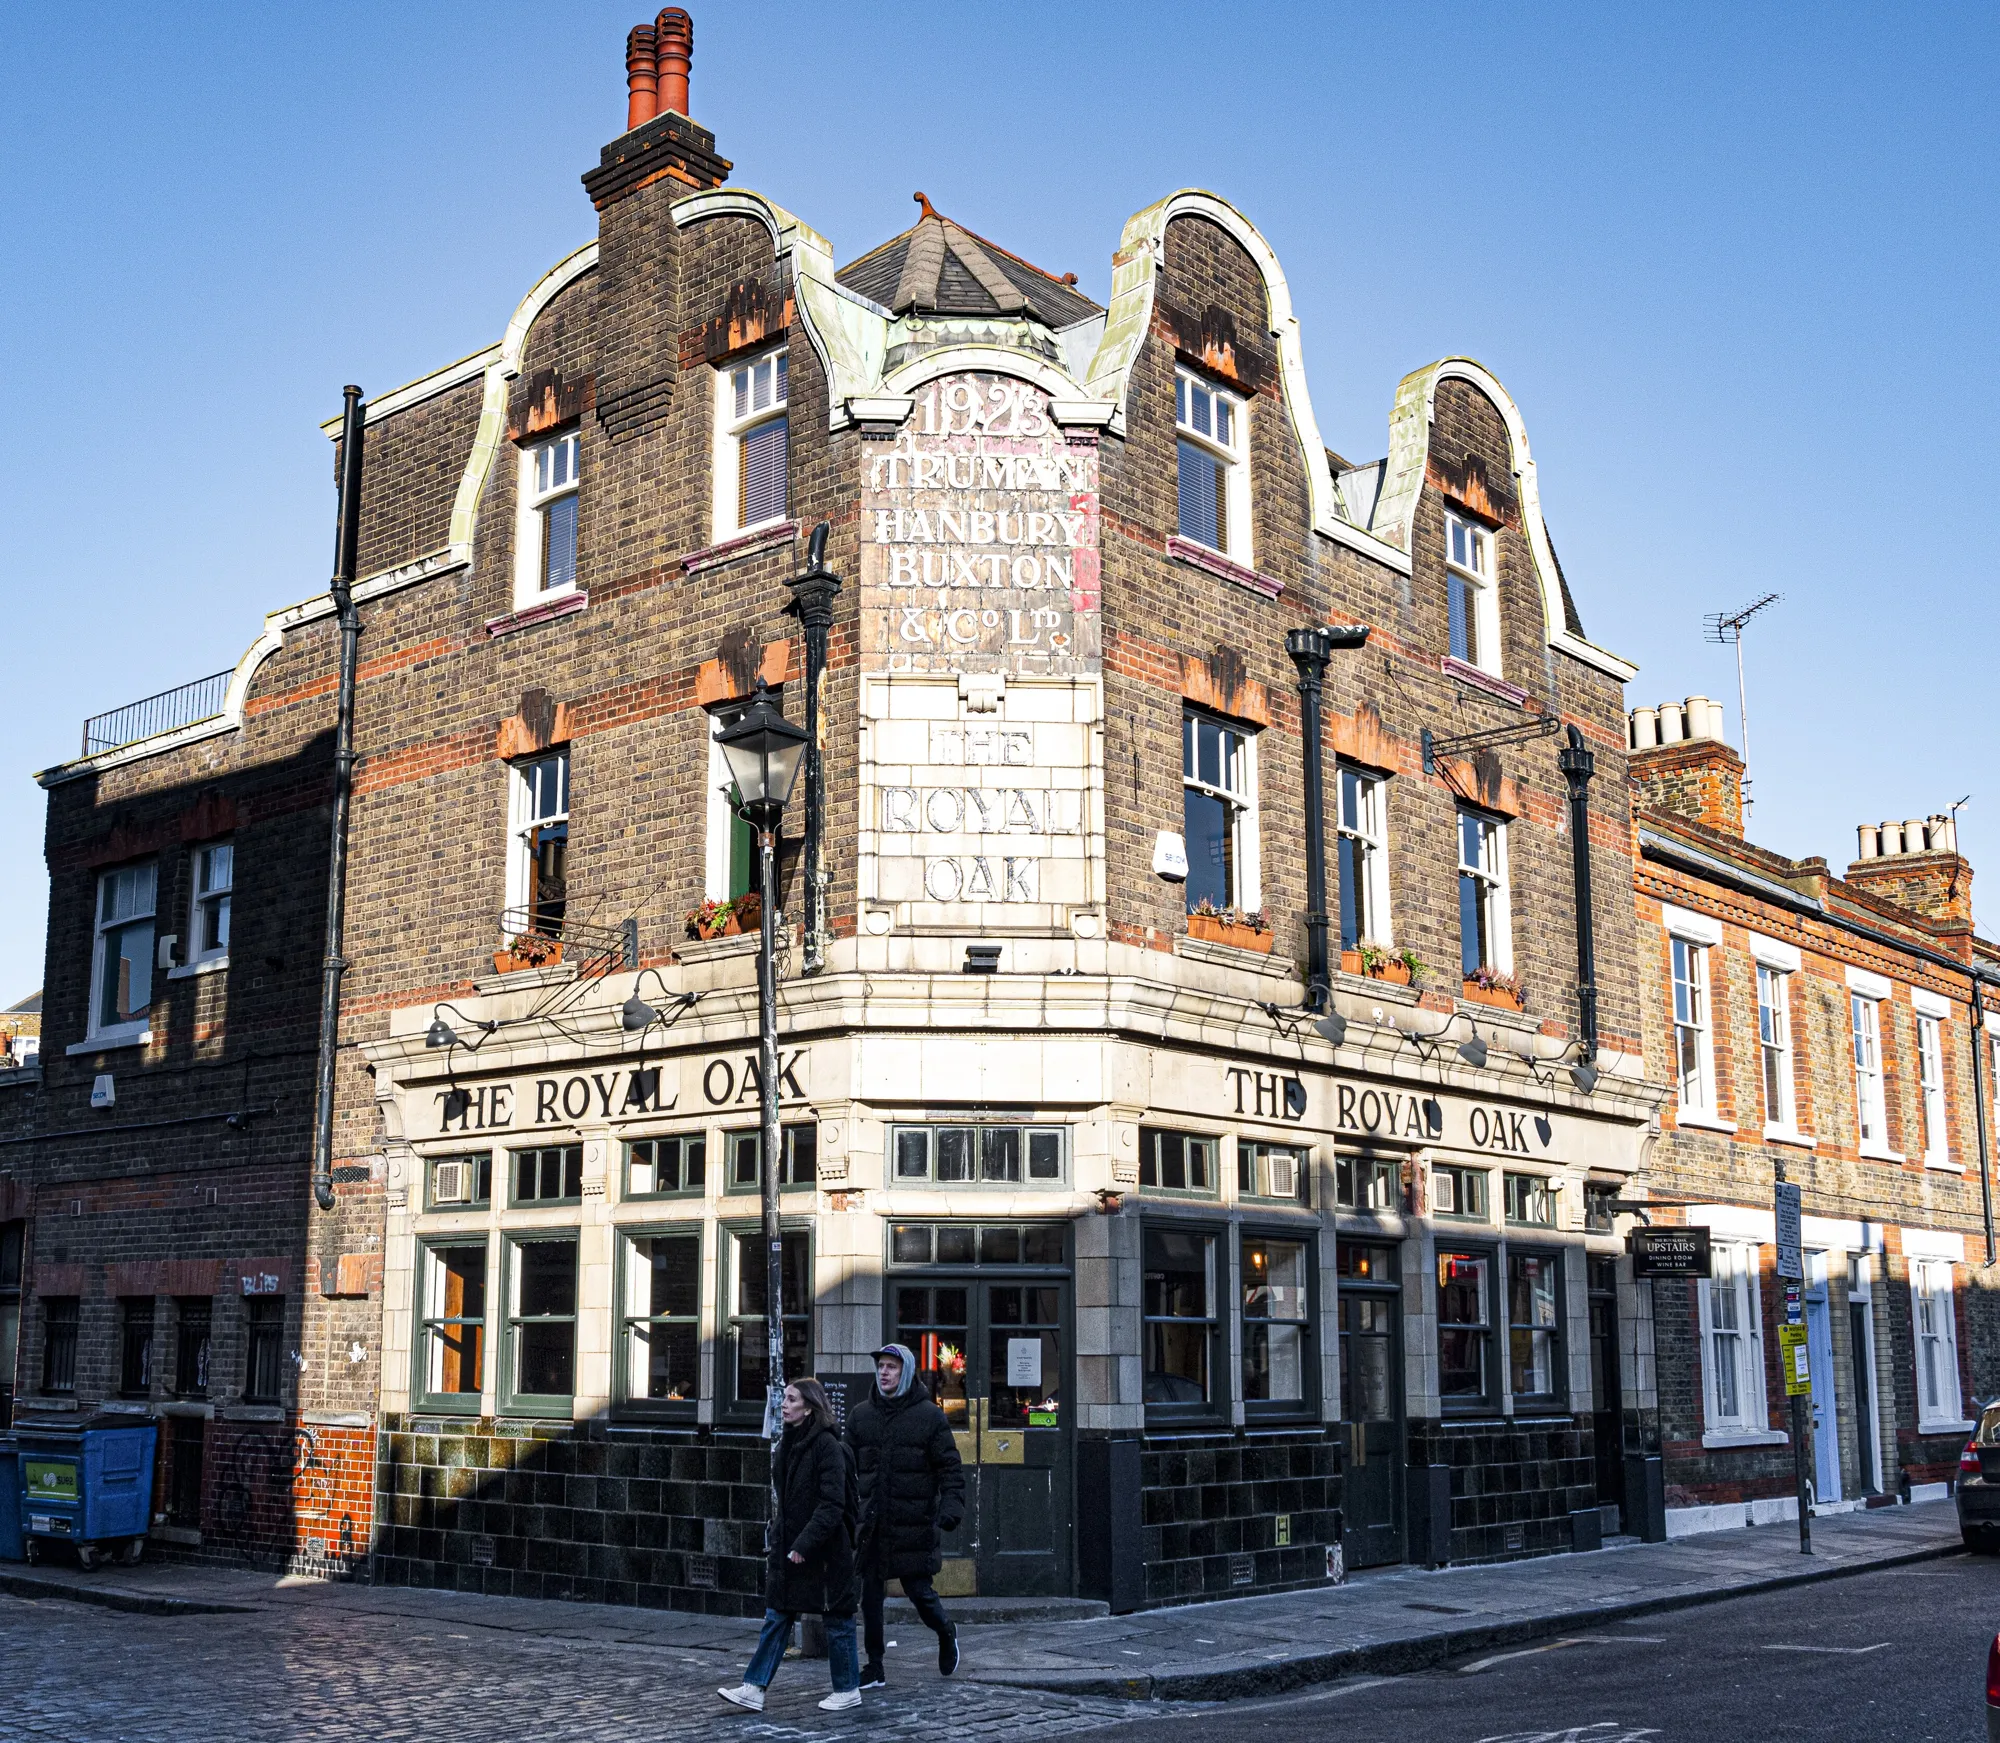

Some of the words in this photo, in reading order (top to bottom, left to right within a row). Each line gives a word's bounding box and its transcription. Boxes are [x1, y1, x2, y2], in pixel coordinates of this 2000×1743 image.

[919, 383, 1050, 437] 1923
[876, 455, 1087, 491] TRUMAN
[876, 510, 1084, 546] HANBURY
[890, 552, 1072, 590] BUXTON
[931, 730, 1032, 766] THE
[881, 787, 1083, 835] ROYAL
[1165, 853, 1185, 863] SEOM
[924, 856, 1039, 903] OAK
[433, 1083, 514, 1133] THE
[534, 1066, 679, 1124] ROYAL
[703, 1050, 811, 1106] OAK
[1225, 1067, 1303, 1122] THE
[1337, 1084, 1443, 1141] ROYAL
[1469, 1107, 1530, 1153] OAK
[1647, 1242, 1695, 1251] UPSTAIRS
